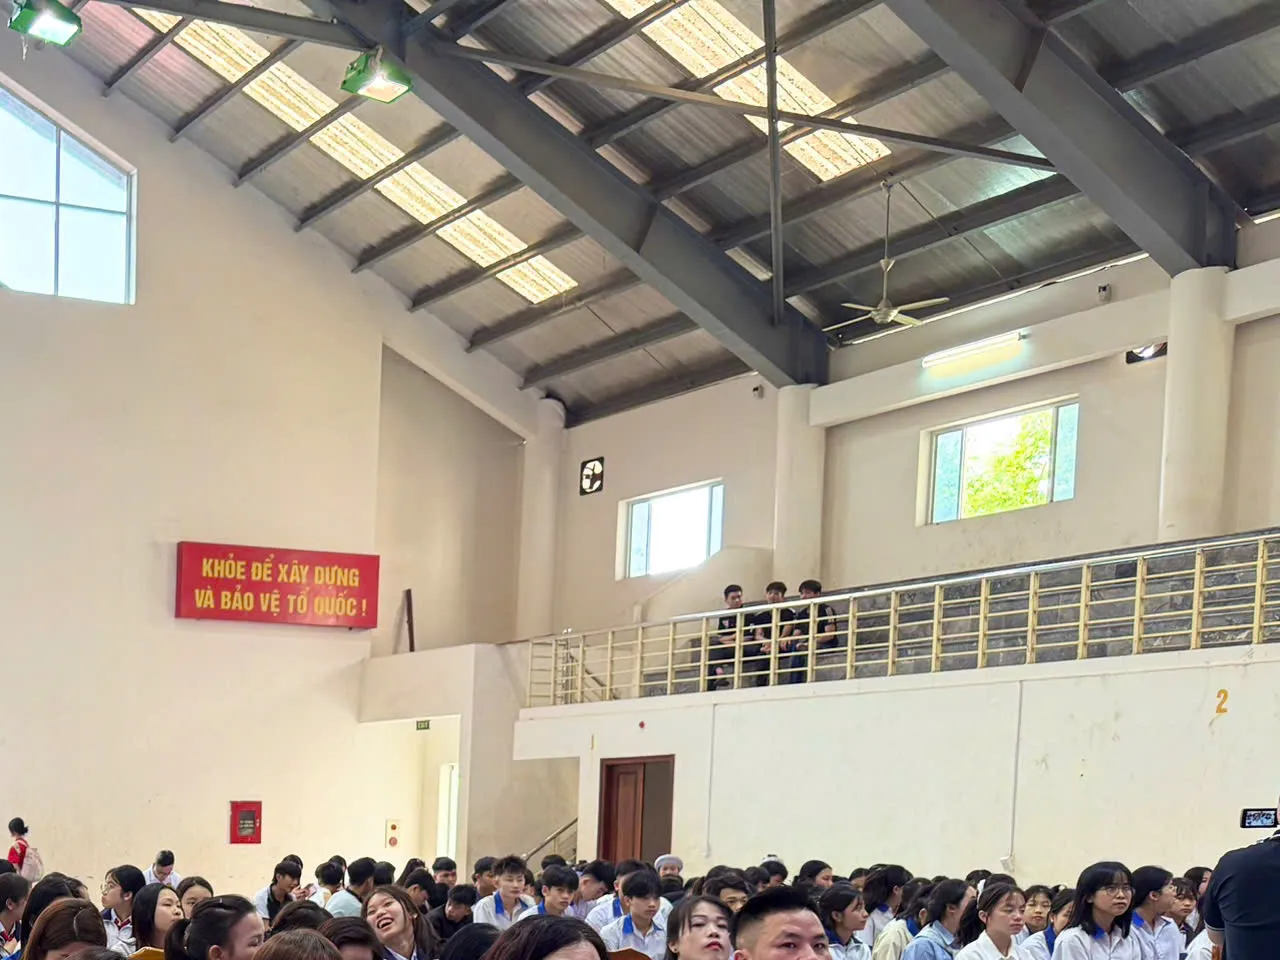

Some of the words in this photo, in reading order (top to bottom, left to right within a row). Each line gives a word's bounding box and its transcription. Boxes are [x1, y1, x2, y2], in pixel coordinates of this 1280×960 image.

[202, 553, 246, 580] KHỎE
[251, 554, 274, 582] ĐỂ
[278, 560, 308, 584] XÂY
[315, 565, 359, 589] DỰNG
[195, 585, 214, 608] VÀ
[221, 585, 254, 610] BẢO
[260, 590, 280, 616] VỆ
[287, 587, 310, 614] TỔ
[1216, 689, 1228, 713] 2
